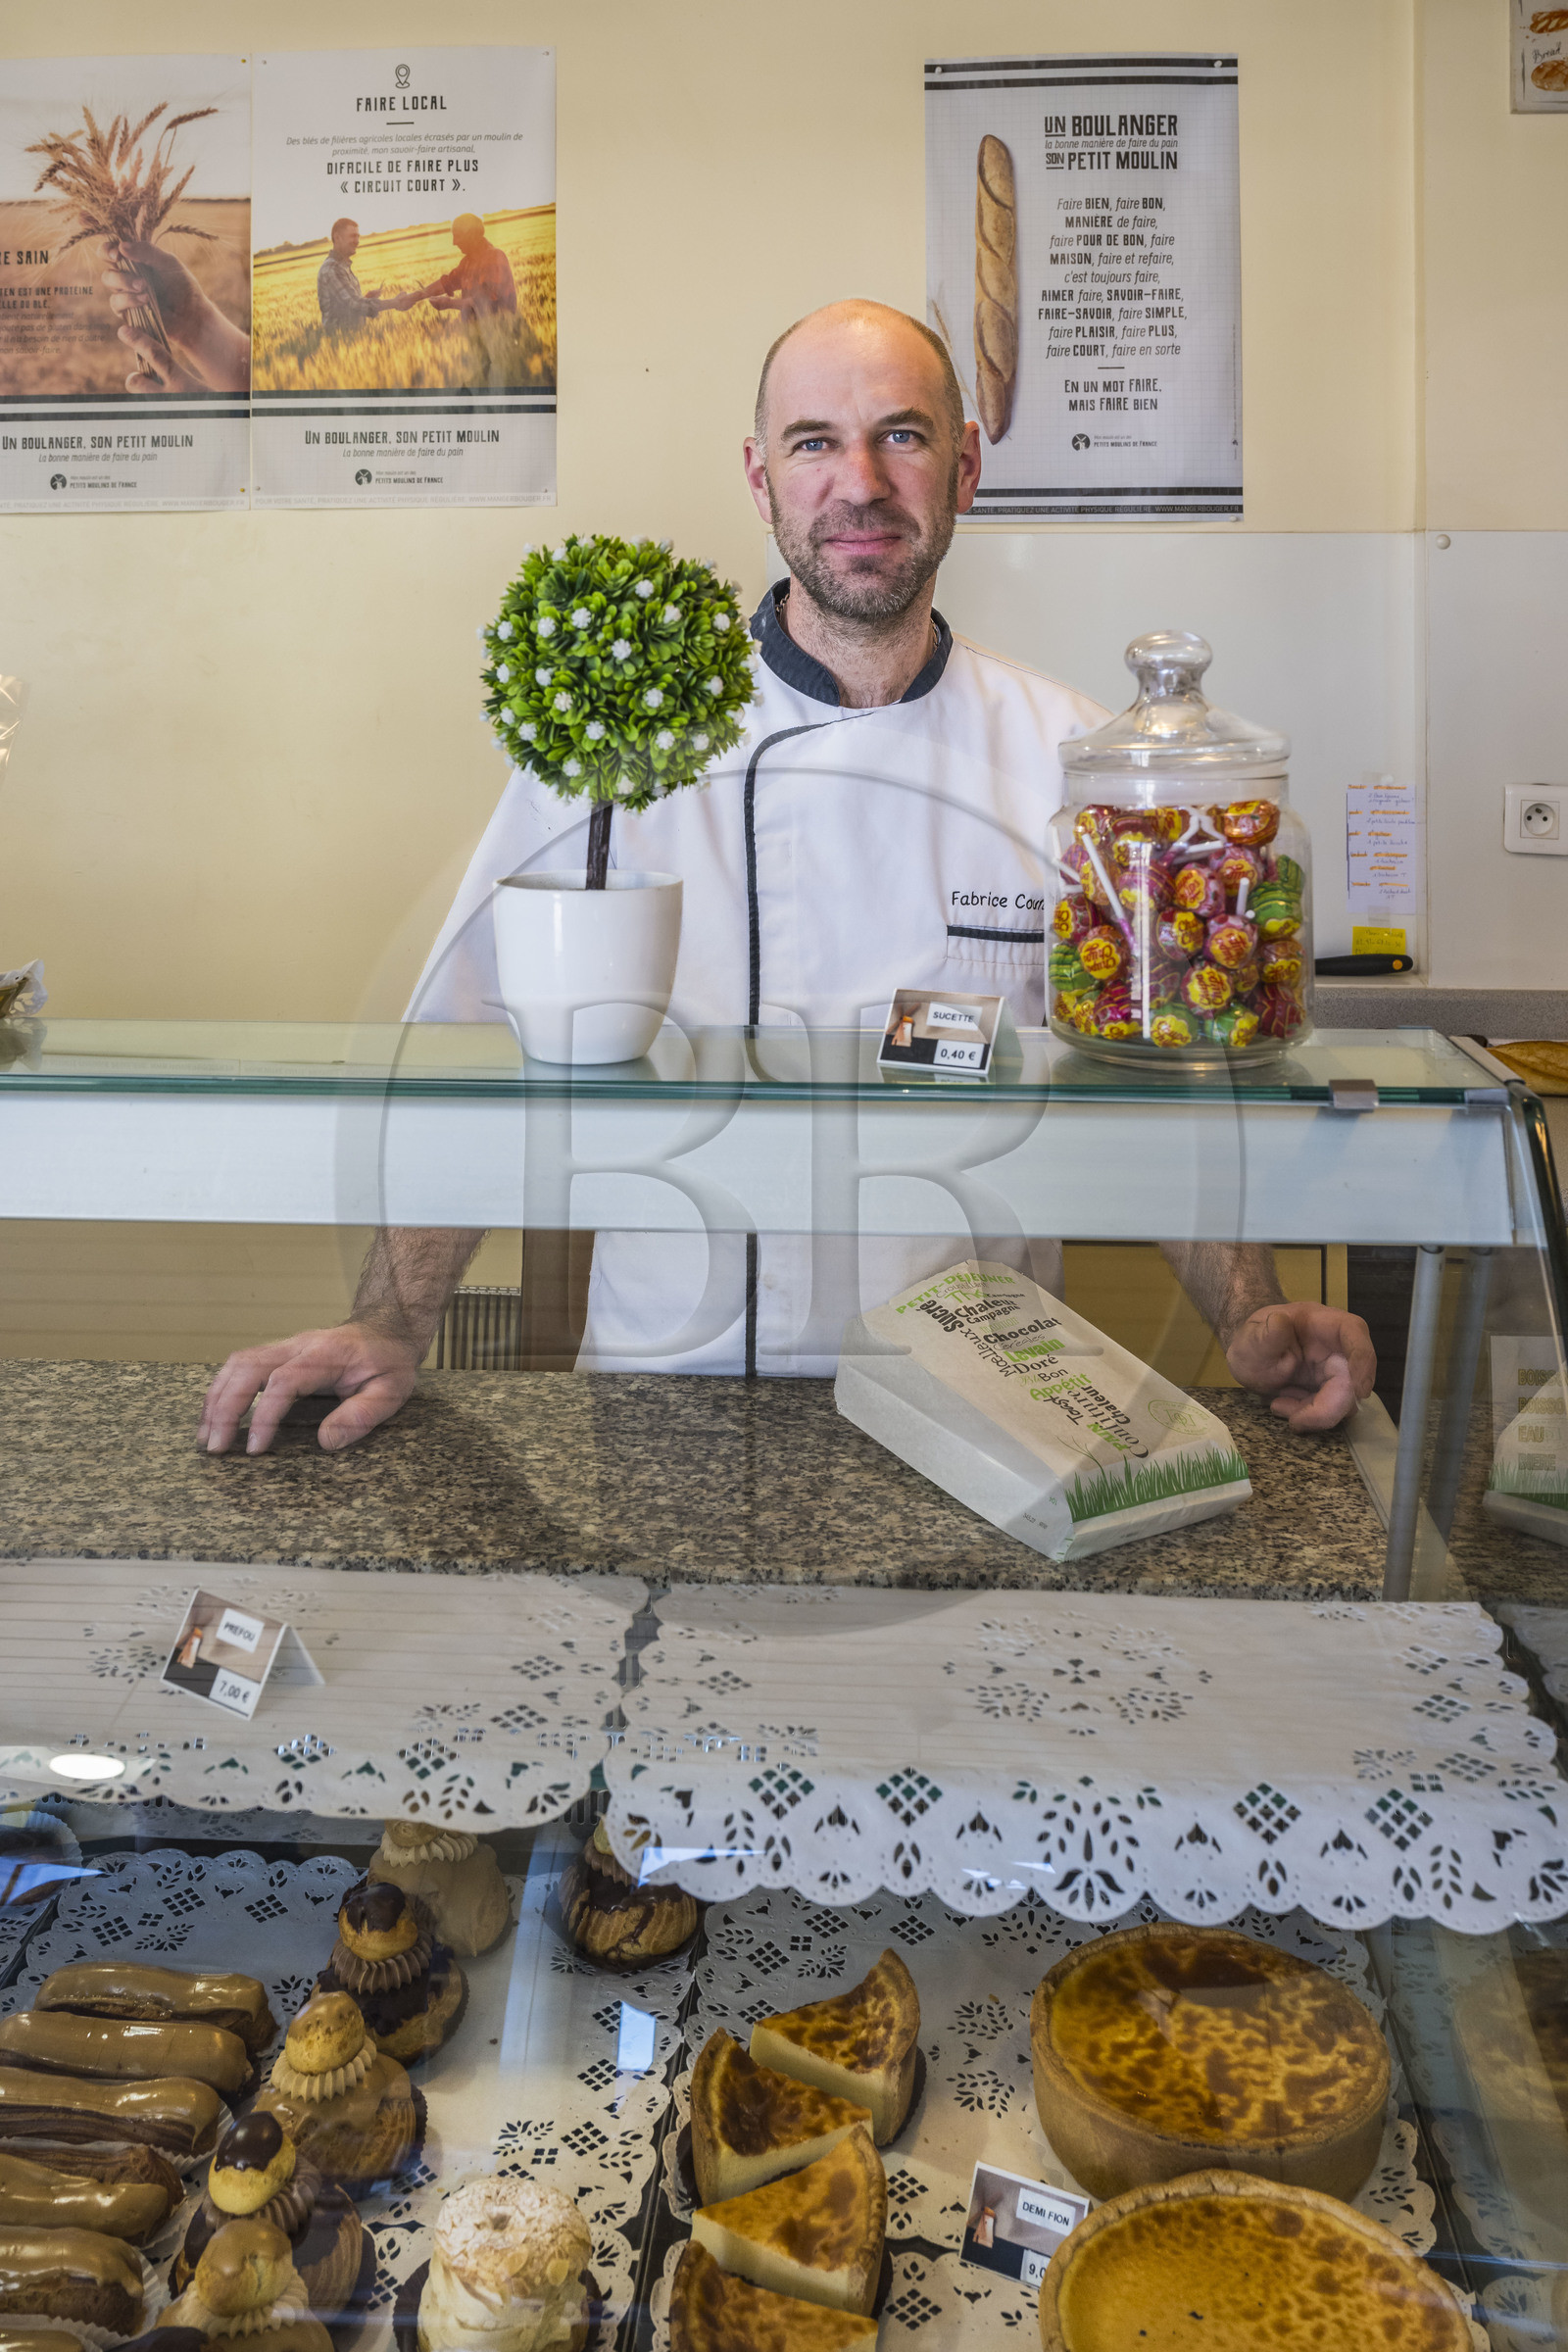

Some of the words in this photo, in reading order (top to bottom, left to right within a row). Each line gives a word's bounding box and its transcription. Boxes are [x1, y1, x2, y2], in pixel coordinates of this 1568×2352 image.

[1532, 41, 1562, 64] Bread
[357, 96, 396, 112] FAIRE
[403, 95, 447, 111] LOCAL
[1045, 116, 1066, 133] UN
[1071, 115, 1178, 136] BOULANGER
[286, 136, 300, 146] Des
[303, 135, 319, 145] blés
[320, 136, 330, 145] de
[359, 134, 393, 146] agricoles
[395, 132, 422, 142] locales
[424, 132, 455, 141] écrasés
[456, 133, 469, 143] par
[484, 132, 512, 141] moulin
[513, 132, 523, 141] de
[1045, 139, 1053, 149] la
[1055, 139, 1080, 149] bonne
[1081, 138, 1113, 148] manière
[1116, 138, 1126, 148] de
[1128, 138, 1148, 149] faire
[1150, 138, 1159, 147] du
[1161, 138, 1178, 149] pain
[390, 144, 436, 155] savoir-faire
[387, 160, 402, 172] DE
[407, 159, 442, 172] FAIRE
[448, 159, 479, 172] PLUS
[1046, 152, 1065, 165] SON
[1068, 151, 1111, 171] PETIT
[1115, 151, 1178, 170] MOULIN
[354, 179, 402, 193] CIRCUIT
[407, 178, 446, 192] COURT
[1056, 198, 1083, 211] Faire
[1085, 198, 1112, 212] BIEN,
[1115, 198, 1140, 212] faire
[1142, 197, 1166, 212] BON,
[1065, 214, 1113, 228] MANIÈRE
[1117, 216, 1129, 228] de
[1131, 216, 1158, 229] faire,
[1050, 235, 1074, 249] faire
[1076, 234, 1102, 246] POUR
[1106, 234, 1119, 246] DE
[1123, 234, 1148, 248] BON,
[1150, 234, 1175, 248] faire
[0, 251, 11, 266] E
[17, 250, 49, 266] SAIN
[1050, 253, 1095, 267] MAISON,
[1098, 253, 1122, 267] faire
[1125, 253, 1135, 265] et
[1138, 252, 1174, 267] refaire,
[1064, 271, 1088, 283] c'est
[1091, 271, 1132, 285] toujours
[1134, 270, 1160, 285] faire,
[18, 286, 32, 297] EST
[35, 286, 52, 296] UNE
[1041, 289, 1074, 302] AIMER
[1077, 289, 1103, 304] faire,
[1106, 288, 1184, 303] SAVOIR-FAIRE,
[20, 300, 30, 309] DU
[1038, 308, 1115, 321] FAIRE-SAVOIR,
[1118, 307, 1143, 321] faire
[1145, 306, 1188, 320] SIMPLE,
[1049, 326, 1073, 341] faire
[1075, 325, 1118, 340] PLAISIR,
[1121, 325, 1147, 340] faire
[1148, 324, 1178, 339] PLUS,
[1046, 345, 1070, 359] faire
[1073, 345, 1108, 359] COURT,
[1111, 344, 1136, 359] faire
[1139, 346, 1152, 356] en
[1154, 343, 1181, 356] sorte
[1064, 379, 1079, 393] EN
[1083, 380, 1099, 393] UN
[1102, 380, 1125, 392] MOT
[1069, 399, 1096, 412] MAIS
[1100, 397, 1129, 411] FAIRE
[1133, 398, 1158, 411] BIEN
[2, 436, 18, 450] UN
[90, 435, 113, 449] SON
[117, 434, 147, 449] PETIT
[151, 434, 194, 448] MOULIN
[305, 430, 320, 444] UN
[396, 430, 418, 444] SON
[421, 430, 453, 444] PETIT
[456, 429, 501, 443] MOULIN
[38, 453, 48, 463] La
[48, 453, 70, 463] bonne
[71, 452, 100, 463] manière
[101, 453, 112, 462] de
[112, 452, 130, 464] faire
[131, 452, 141, 462] du
[141, 452, 158, 464] pain
[342, 448, 351, 458] La
[353, 447, 375, 458] bonne
[376, 447, 406, 458] manière
[407, 447, 416, 457] de
[416, 447, 436, 459] faire
[437, 447, 447, 457] du
[447, 447, 464, 459] pain
[952, 891, 1008, 907] Fabrice
[933, 1010, 975, 1023] SUCETTE
[940, 1048, 965, 1060] 0,40
[968, 1051, 977, 1061] €
[895, 1272, 1016, 1315] PETIT-DÉJEUNER
[915, 1299, 964, 1333] Sucré
[955, 1298, 1018, 1318] Chaleur
[983, 1317, 1063, 1344] Chocolat
[1004, 1339, 1066, 1362] Levain
[1012, 1353, 1059, 1374] Doré
[1037, 1368, 1069, 1383] Bon
[1029, 1373, 1093, 1401] Appétit
[1043, 1396, 1084, 1426] Toast
[1081, 1385, 1132, 1426] Chaleur
[1067, 1390, 1150, 1459] Confiture
[1086, 1422, 1130, 1452] PAIN
[1518, 1425, 1544, 1443] EAU
[241, 1690, 252, 1704] €
[1022, 2201, 1046, 2218] DEMI
[1048, 2210, 1070, 2227] FION
